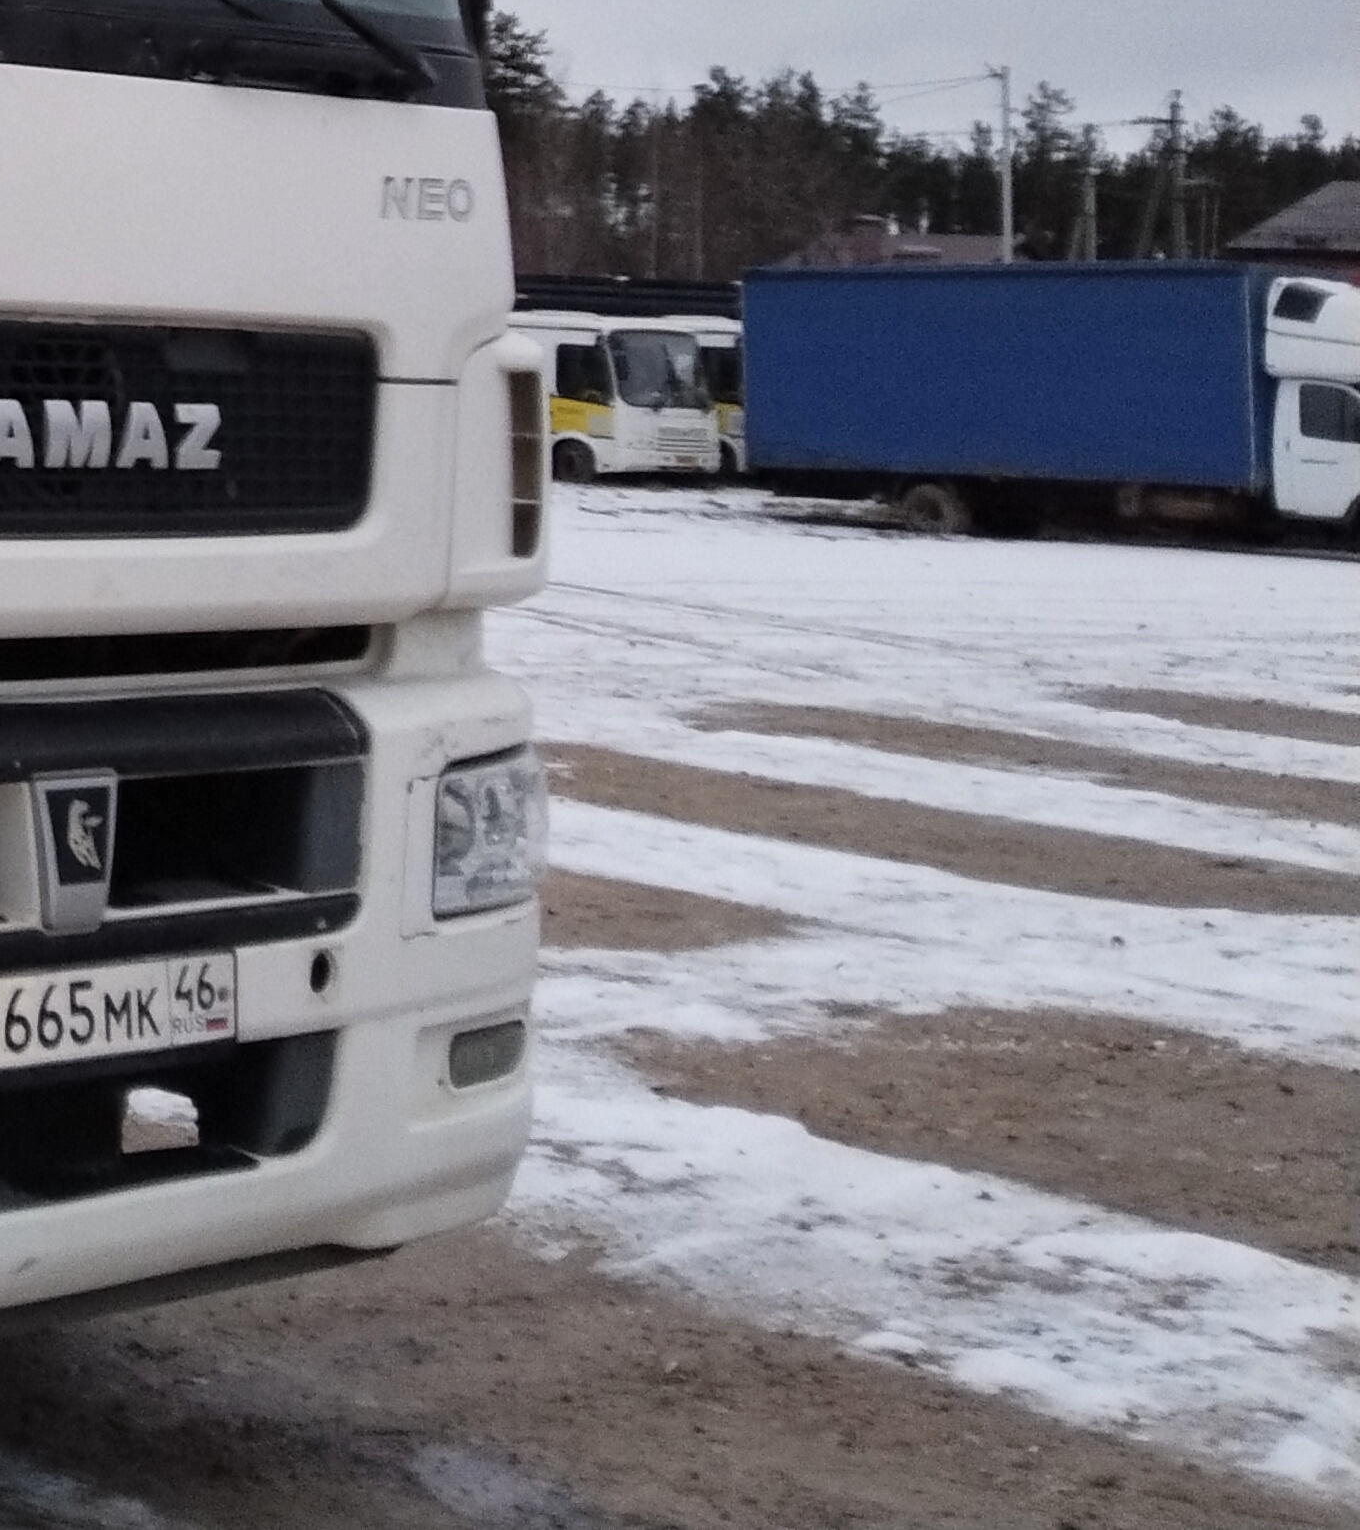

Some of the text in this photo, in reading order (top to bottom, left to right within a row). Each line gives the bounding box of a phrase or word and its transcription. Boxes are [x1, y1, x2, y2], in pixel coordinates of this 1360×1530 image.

[380, 176, 473, 222] NEO
[174, 963, 216, 1012] 46
[171, 1014, 205, 1034] RUS
